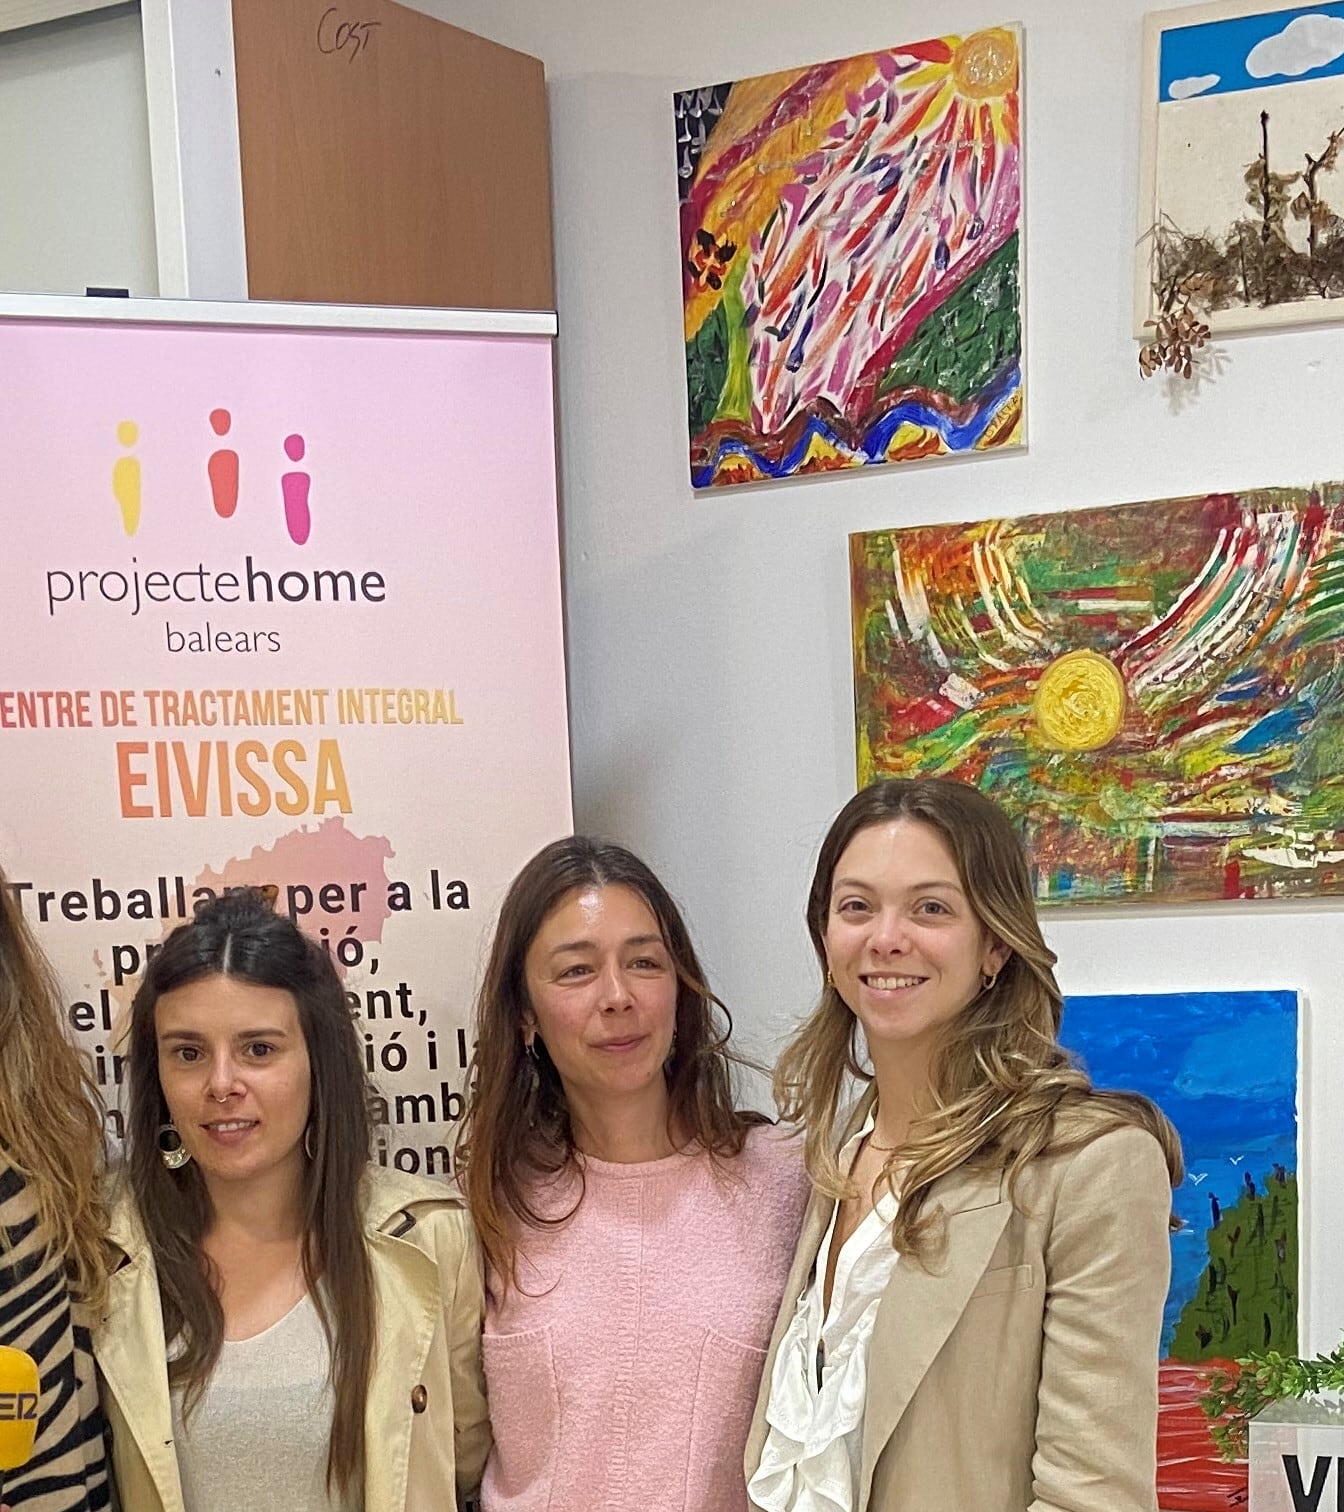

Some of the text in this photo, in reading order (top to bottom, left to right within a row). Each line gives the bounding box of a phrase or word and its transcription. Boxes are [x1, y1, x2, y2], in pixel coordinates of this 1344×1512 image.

[166, 622, 282, 654] balears
[101, 692, 136, 728] DE
[143, 688, 328, 727] TRACTAMENT
[337, 688, 464, 727] INTEGRAL
[116, 739, 354, 818] EIVISSA
[6, 870, 471, 921] Treballa per a la
